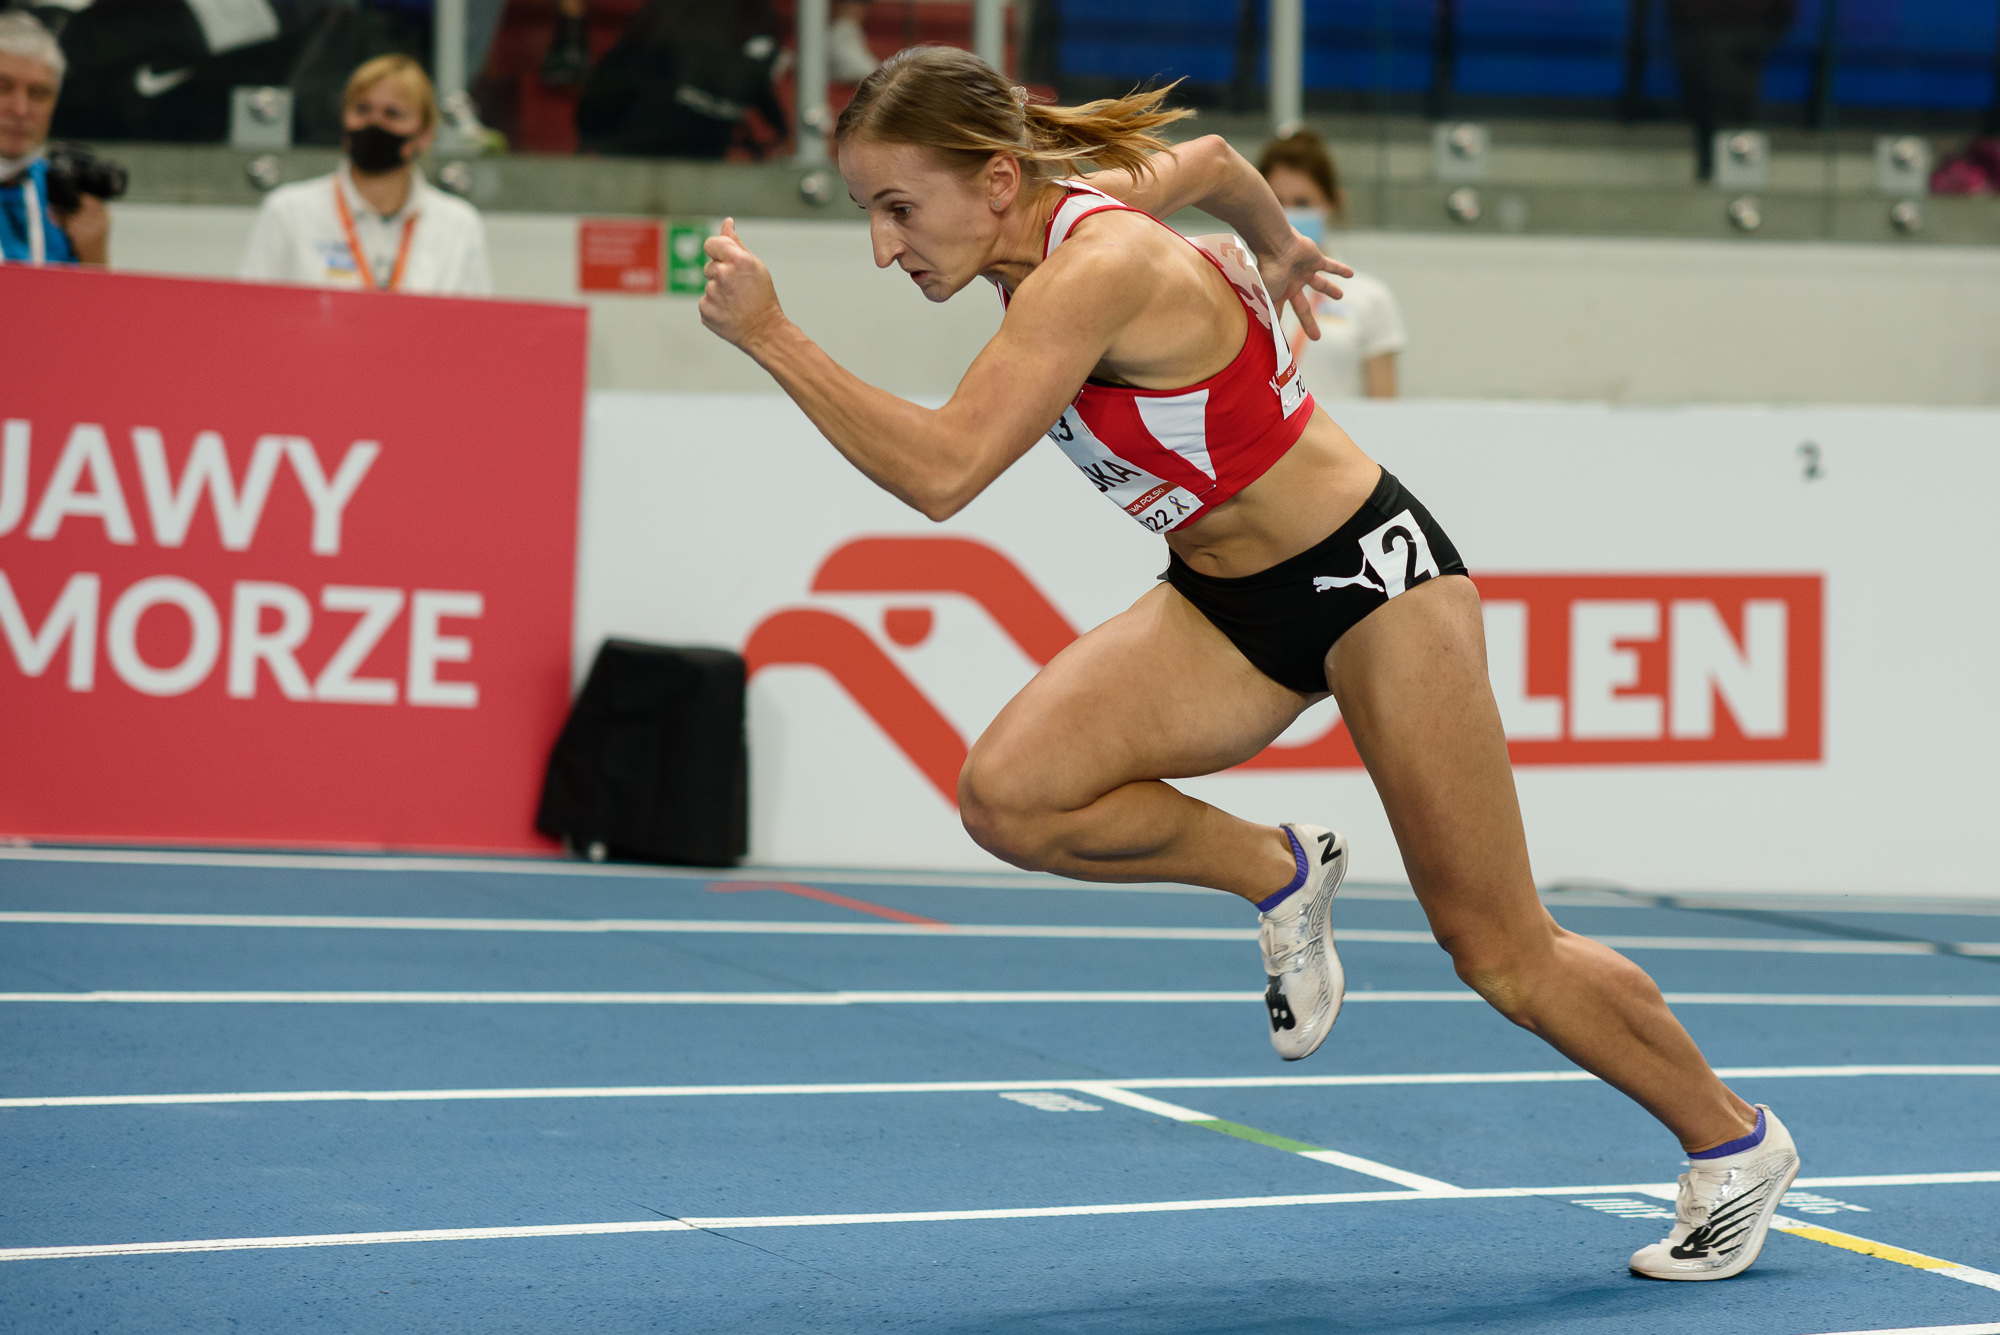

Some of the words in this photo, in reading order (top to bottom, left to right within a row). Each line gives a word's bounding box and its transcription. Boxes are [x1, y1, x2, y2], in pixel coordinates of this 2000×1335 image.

[0, 418, 381, 556] JAWY
[1139, 487, 1166, 507] POLSKI
[1381, 525, 1432, 592] 2
[0, 570, 484, 709] MORZE
